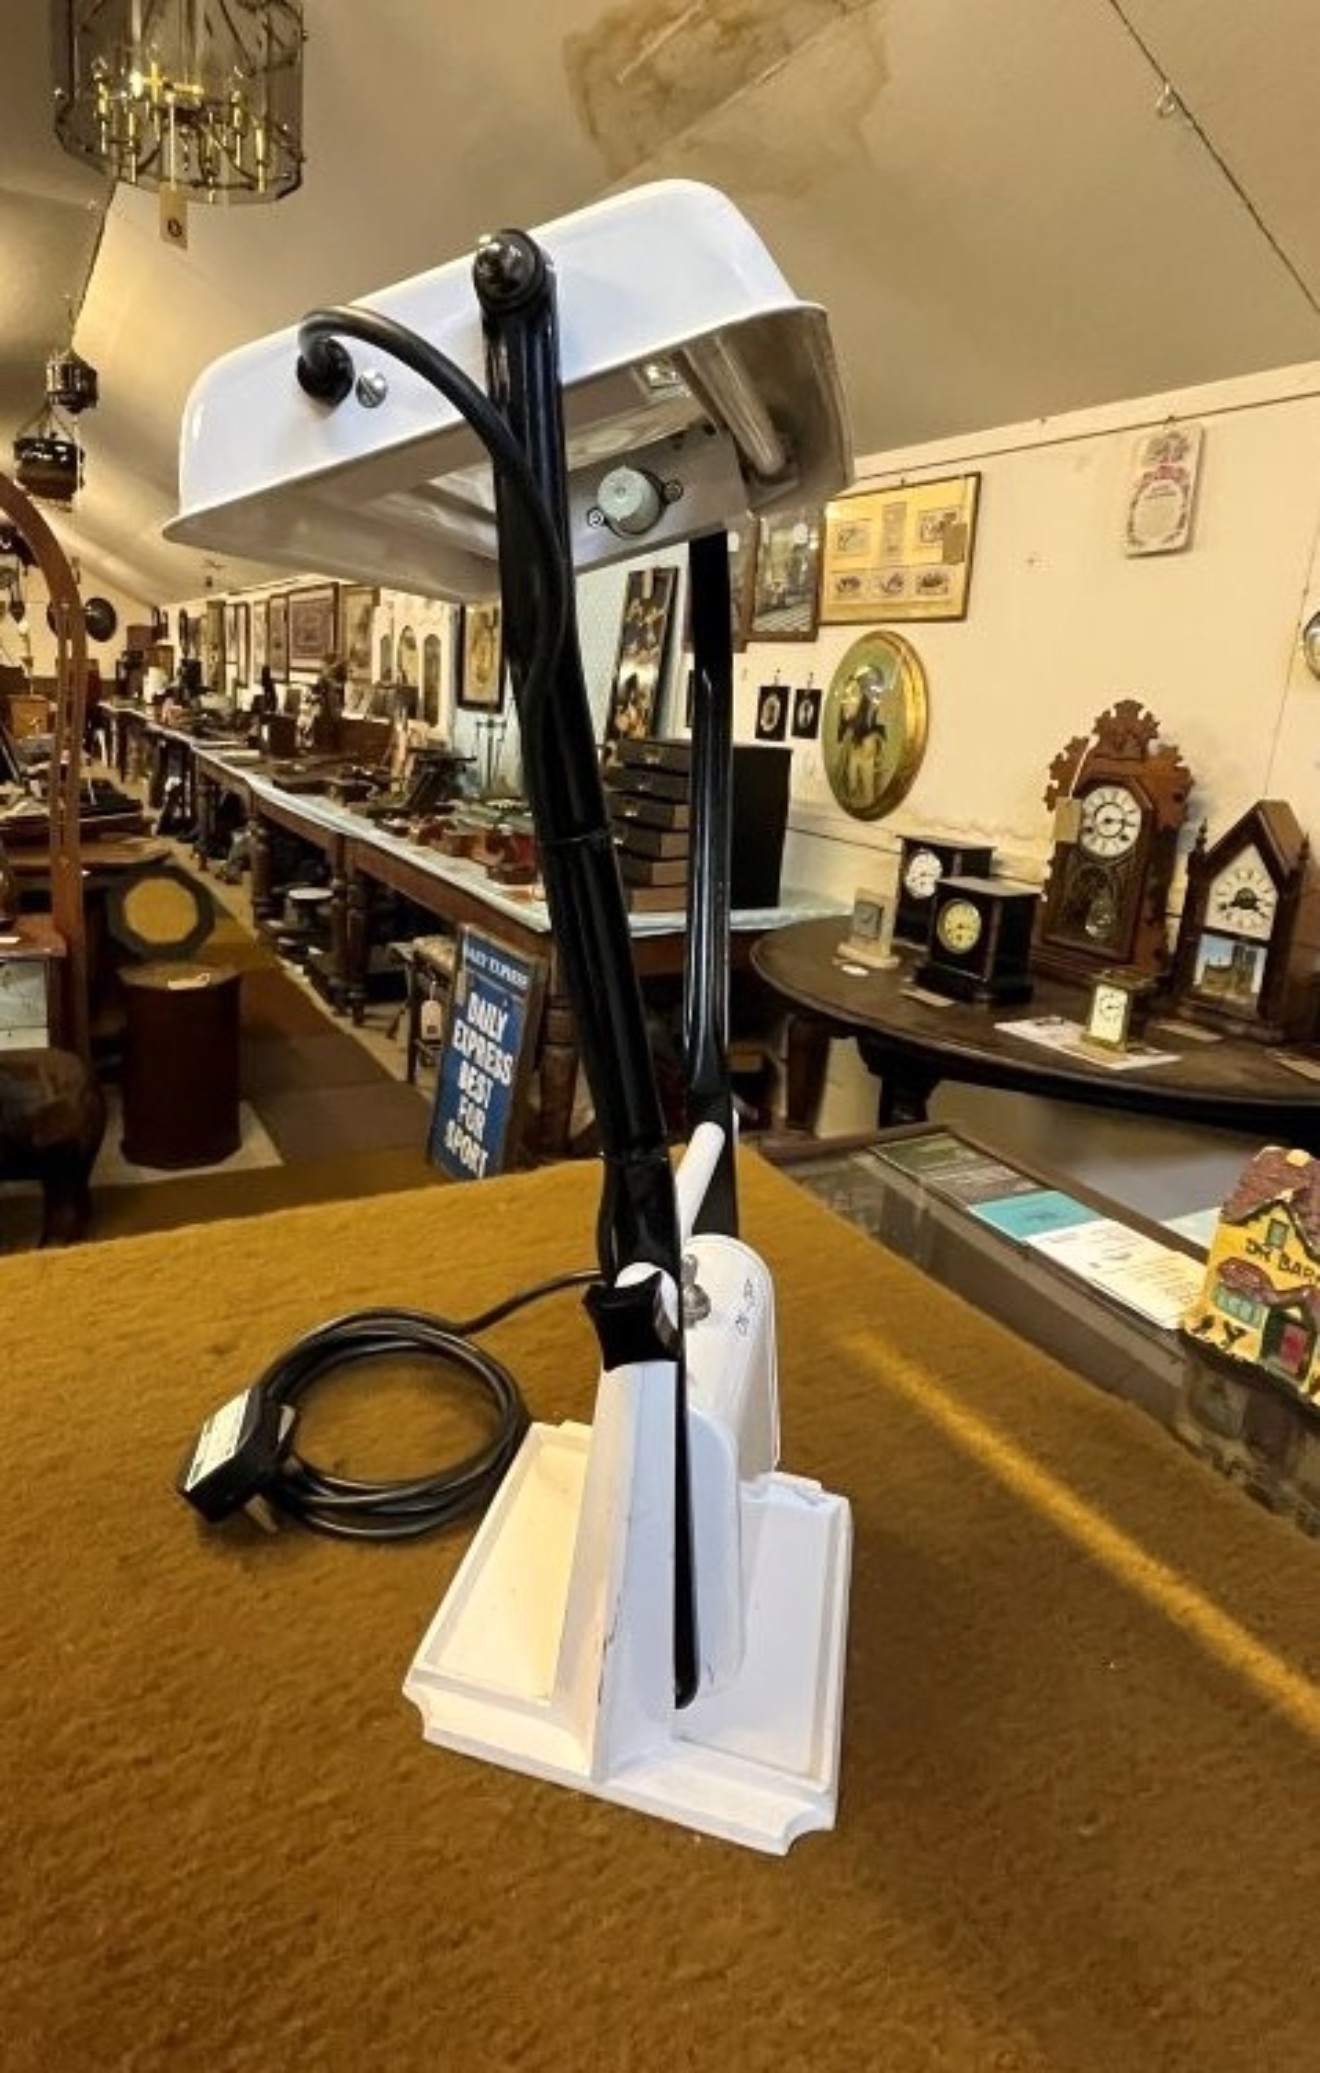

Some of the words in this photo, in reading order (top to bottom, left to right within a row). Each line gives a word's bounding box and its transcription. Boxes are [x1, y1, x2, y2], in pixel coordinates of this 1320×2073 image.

[468, 991, 508, 1043] DAILY
[453, 1018, 513, 1086] EXPRESS
[458, 1060, 494, 1110] BEST
[457, 1094, 486, 1142] FOR
[444, 1118, 489, 1179] SPORT
